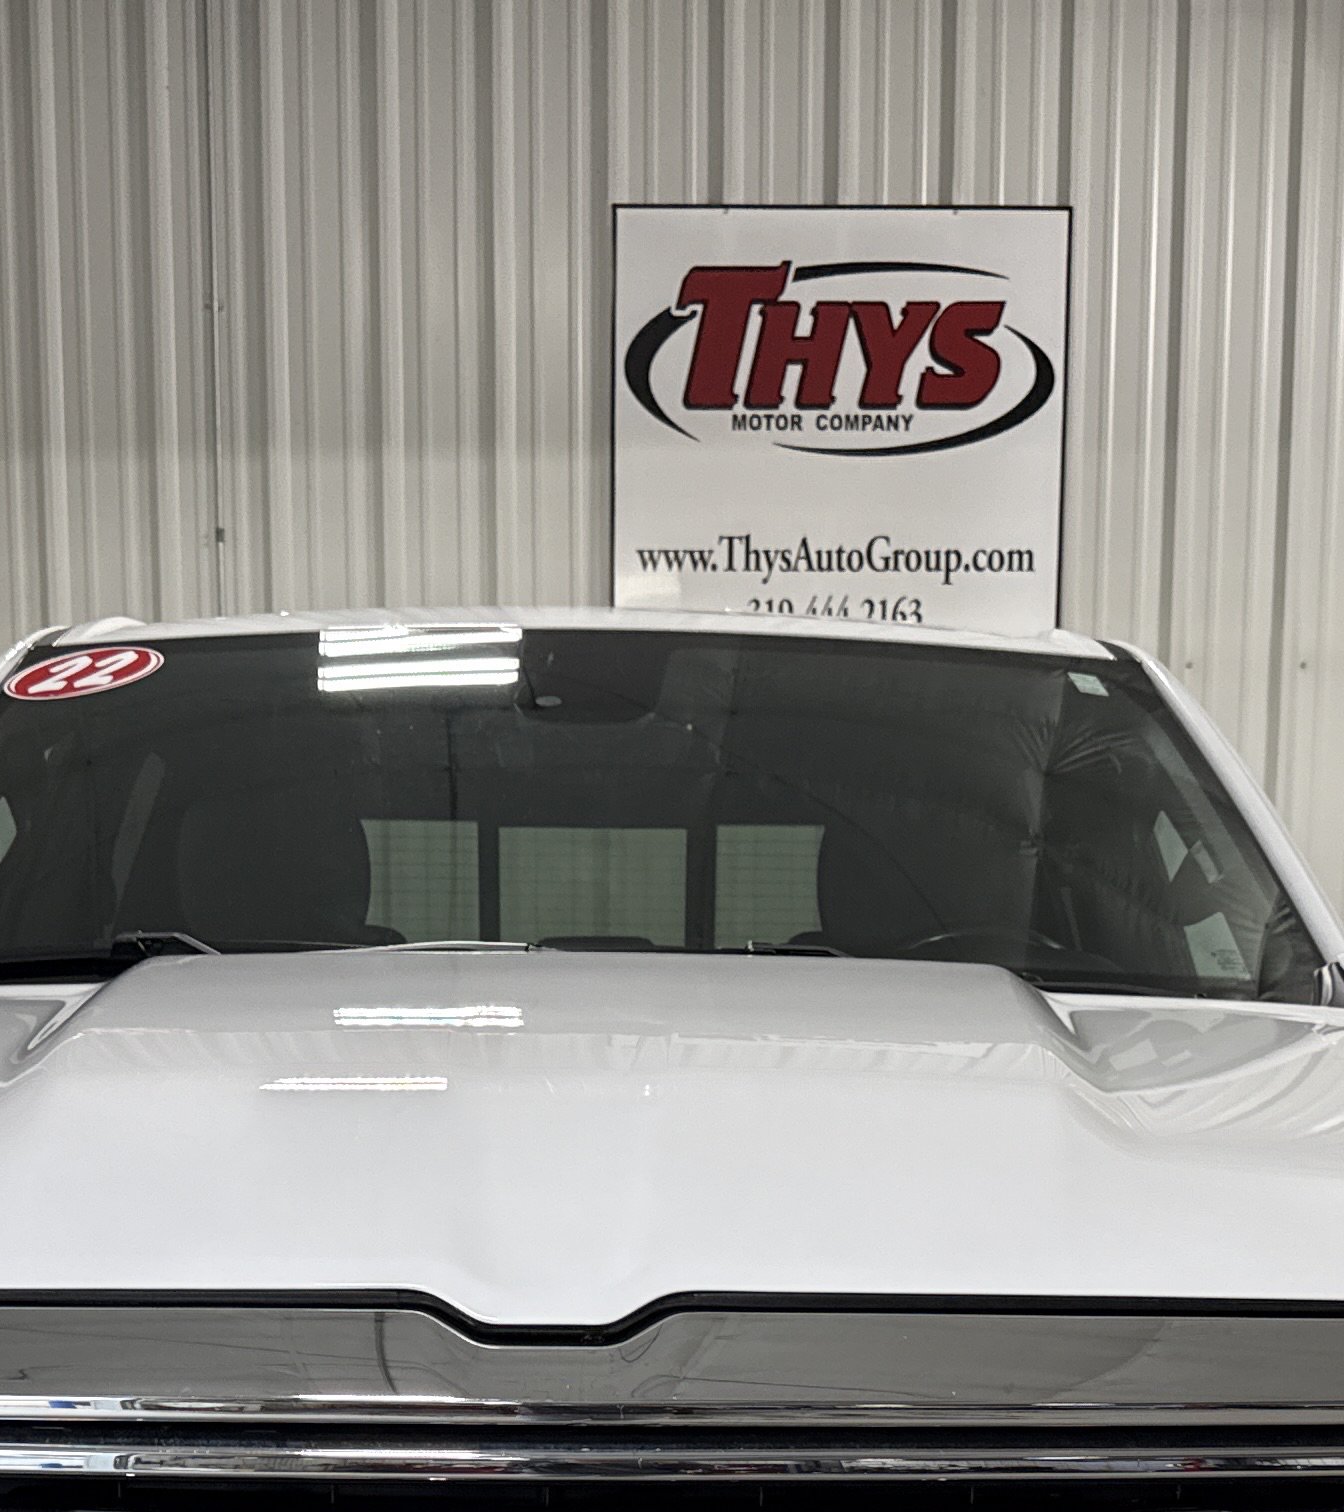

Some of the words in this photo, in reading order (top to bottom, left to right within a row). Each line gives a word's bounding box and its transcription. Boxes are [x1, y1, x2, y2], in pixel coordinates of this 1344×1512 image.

[676, 260, 1006, 411] THYS
[732, 414, 803, 432] MOTOR
[816, 414, 914, 432] COMPANY
[636, 534, 1035, 585] www.ThysAutoGroup.com
[27, 650, 139, 694] 22
